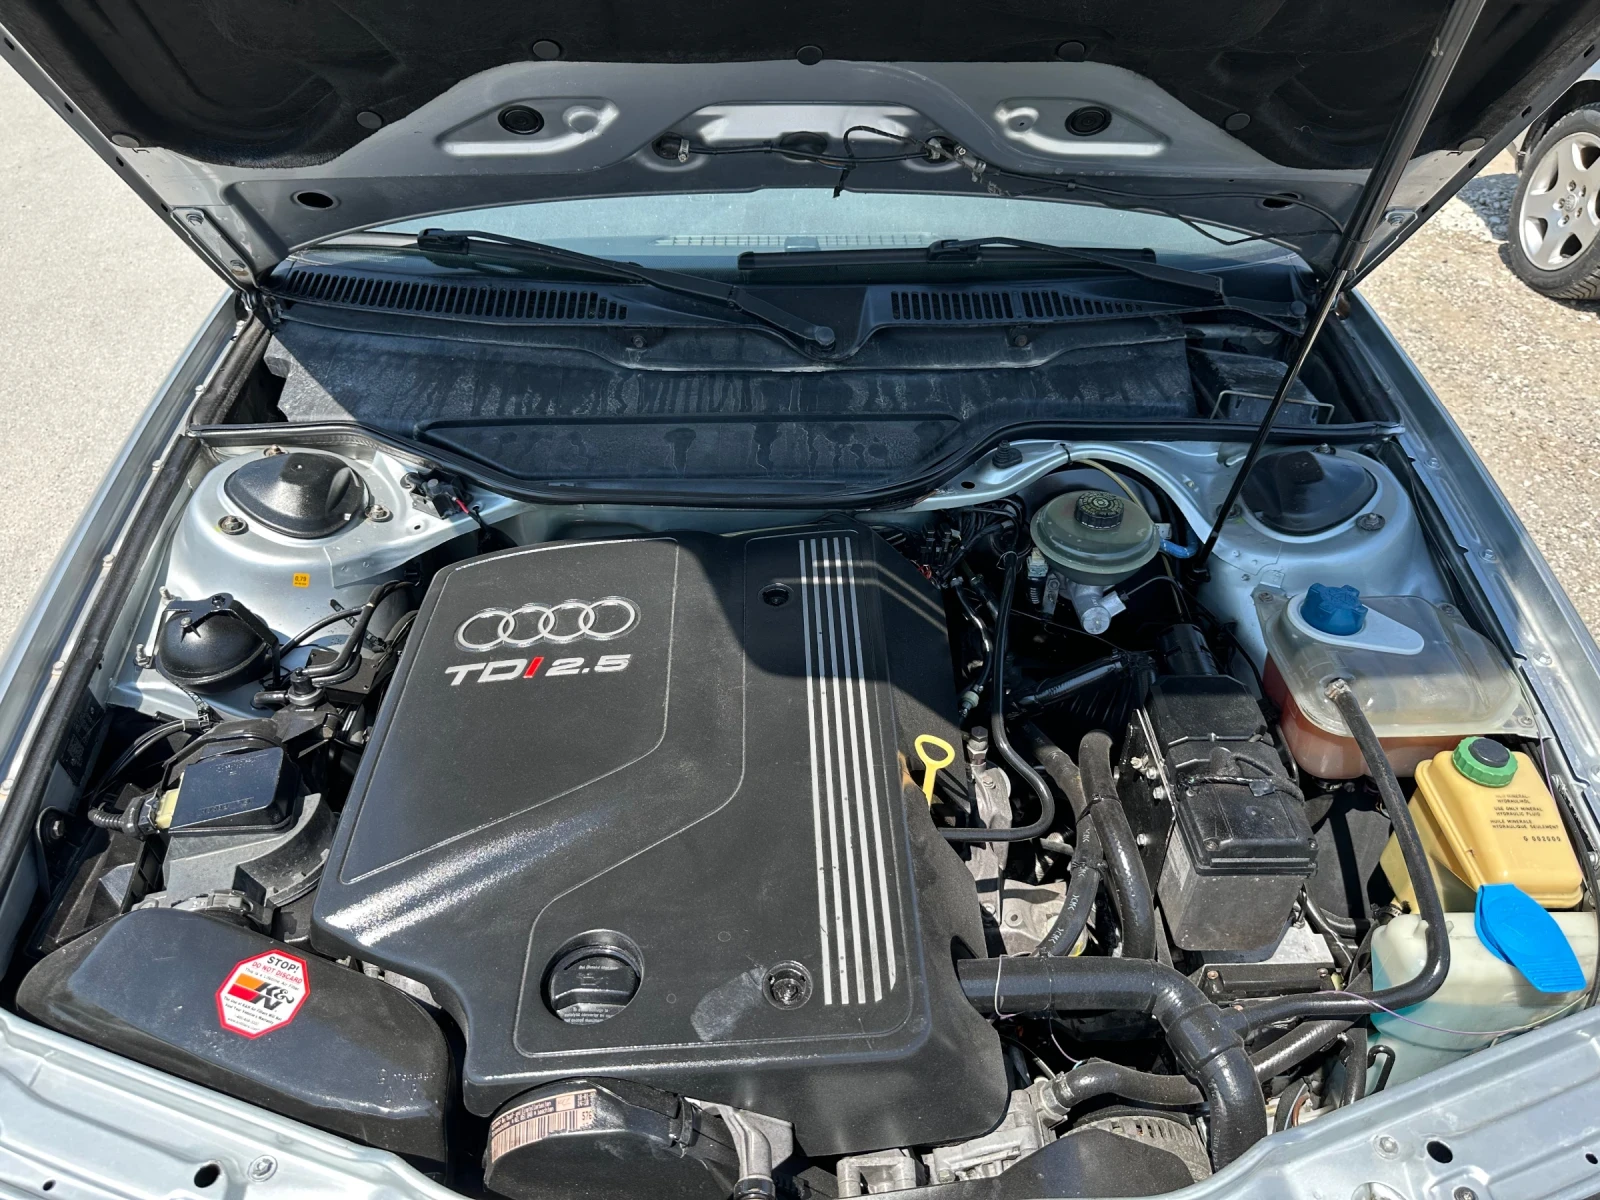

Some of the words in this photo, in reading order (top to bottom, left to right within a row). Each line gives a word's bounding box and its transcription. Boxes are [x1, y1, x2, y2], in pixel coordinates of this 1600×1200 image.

[545, 654, 631, 676] 2.5
[267, 956, 299, 973] STOP!
[262, 965, 276, 974] NOT
[276, 970, 302, 984] DISCARD
[289, 983, 299, 991] Filter
